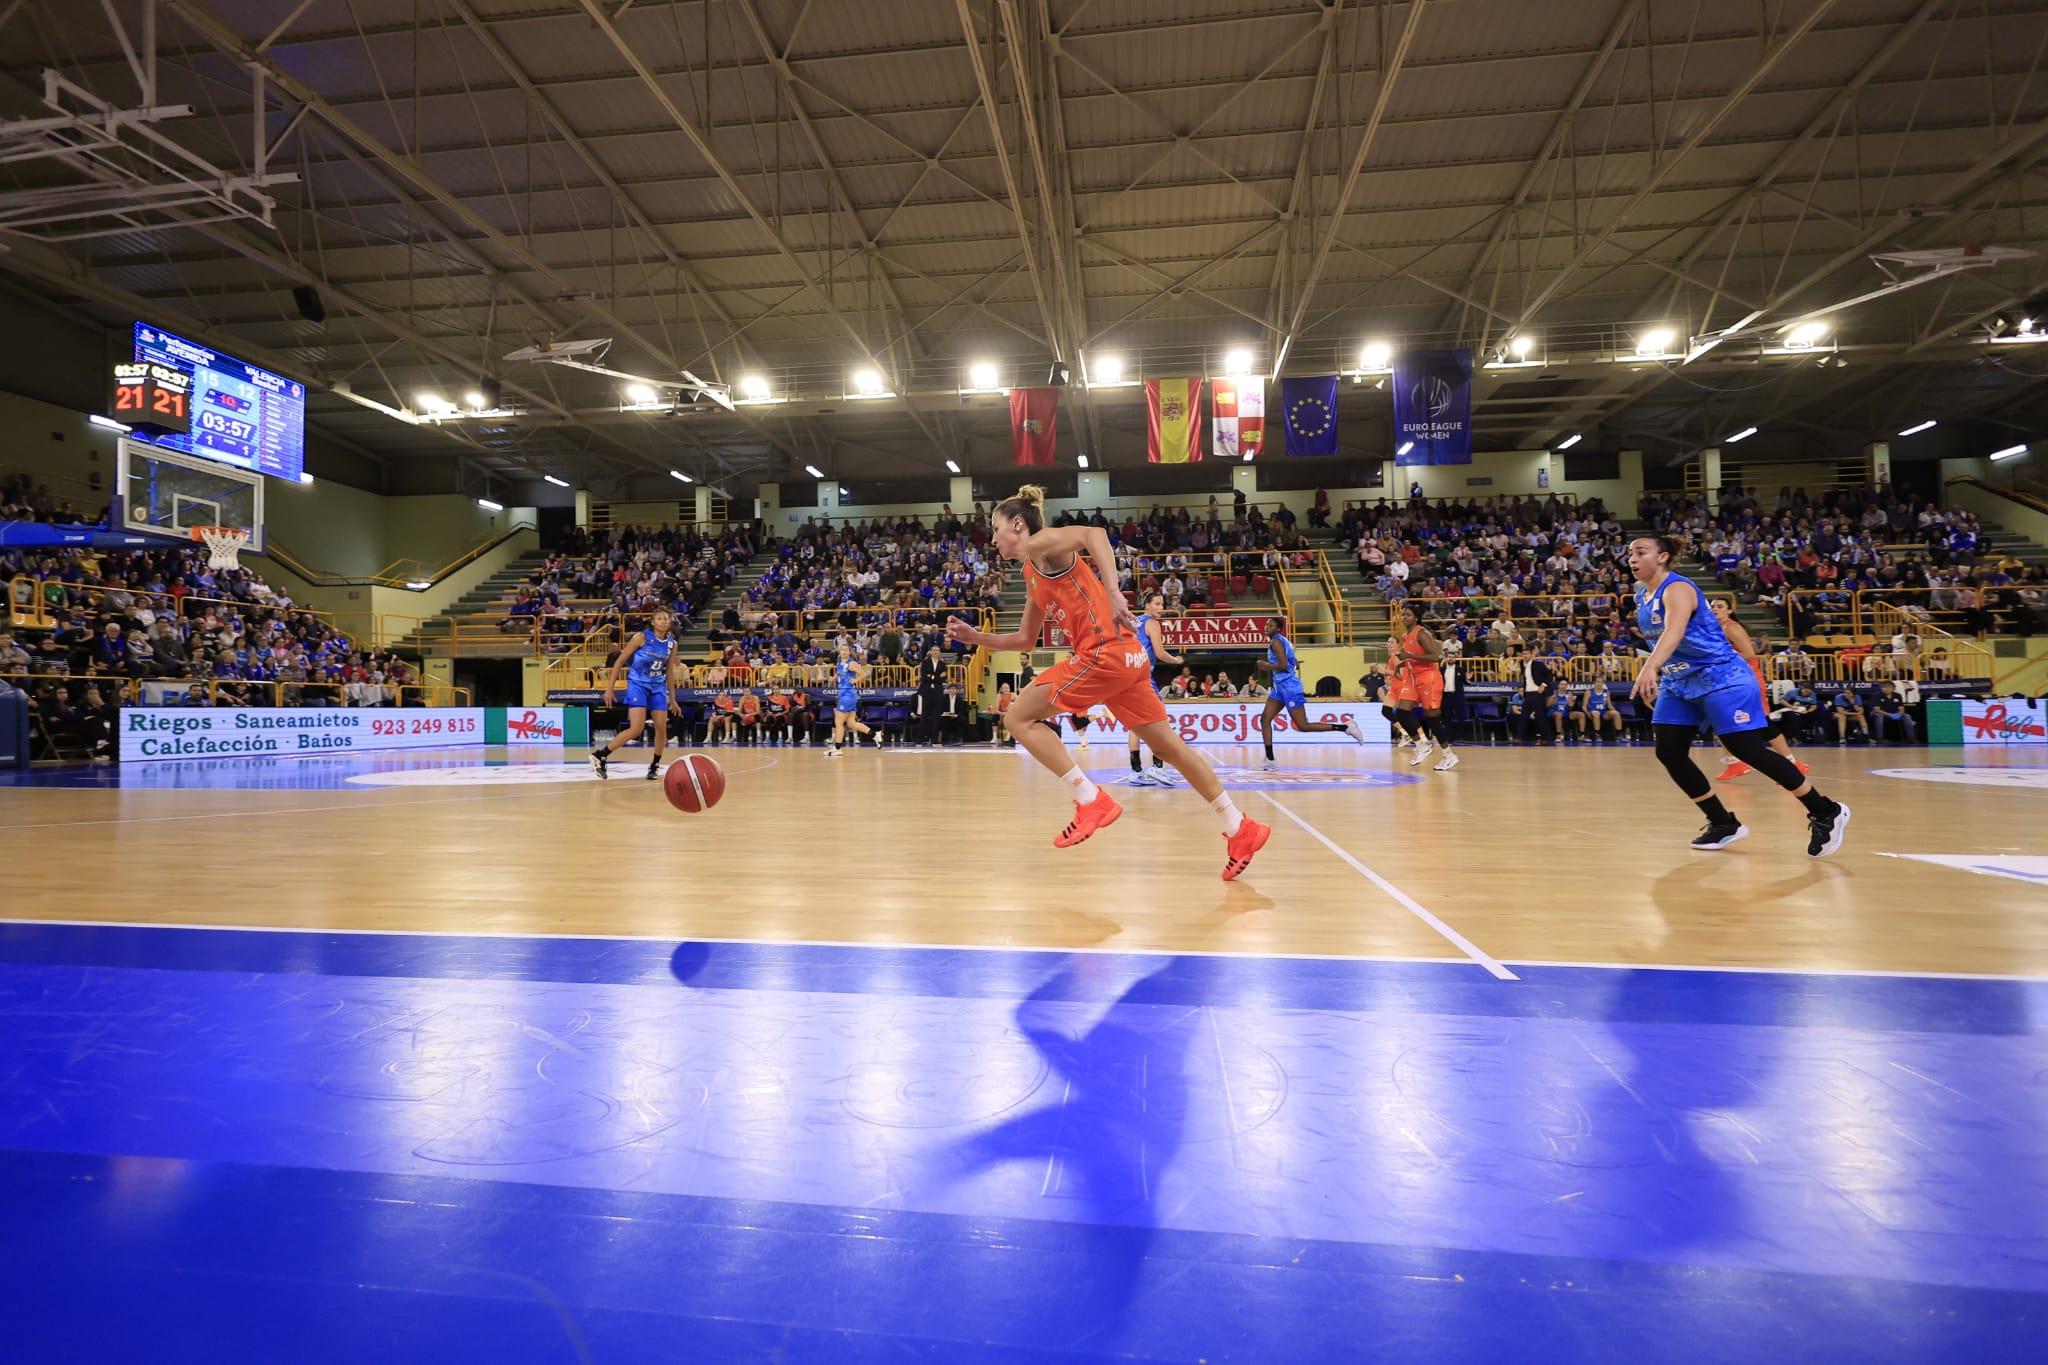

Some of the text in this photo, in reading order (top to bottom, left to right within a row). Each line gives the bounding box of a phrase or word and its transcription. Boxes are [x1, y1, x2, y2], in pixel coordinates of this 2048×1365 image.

[114, 364, 150, 377] 03:57
[151, 365, 190, 387] 03:57
[199, 370, 219, 387] 15
[244, 366, 287, 388] VALENCIA
[115, 385, 184, 418] 21 21
[238, 384, 255, 400] 12
[202, 411, 252, 440] 03:57
[1403, 422, 1463, 432] EUROEAGUE
[1161, 618, 1260, 632] MANCA
[1179, 634, 1195, 644] LA
[1199, 633, 1272, 644] HUMANIDA
[128, 711, 361, 735] Riegos Saneamietos
[372, 717, 476, 736] 923 249 815
[140, 732, 353, 757] Calefacción Baños
